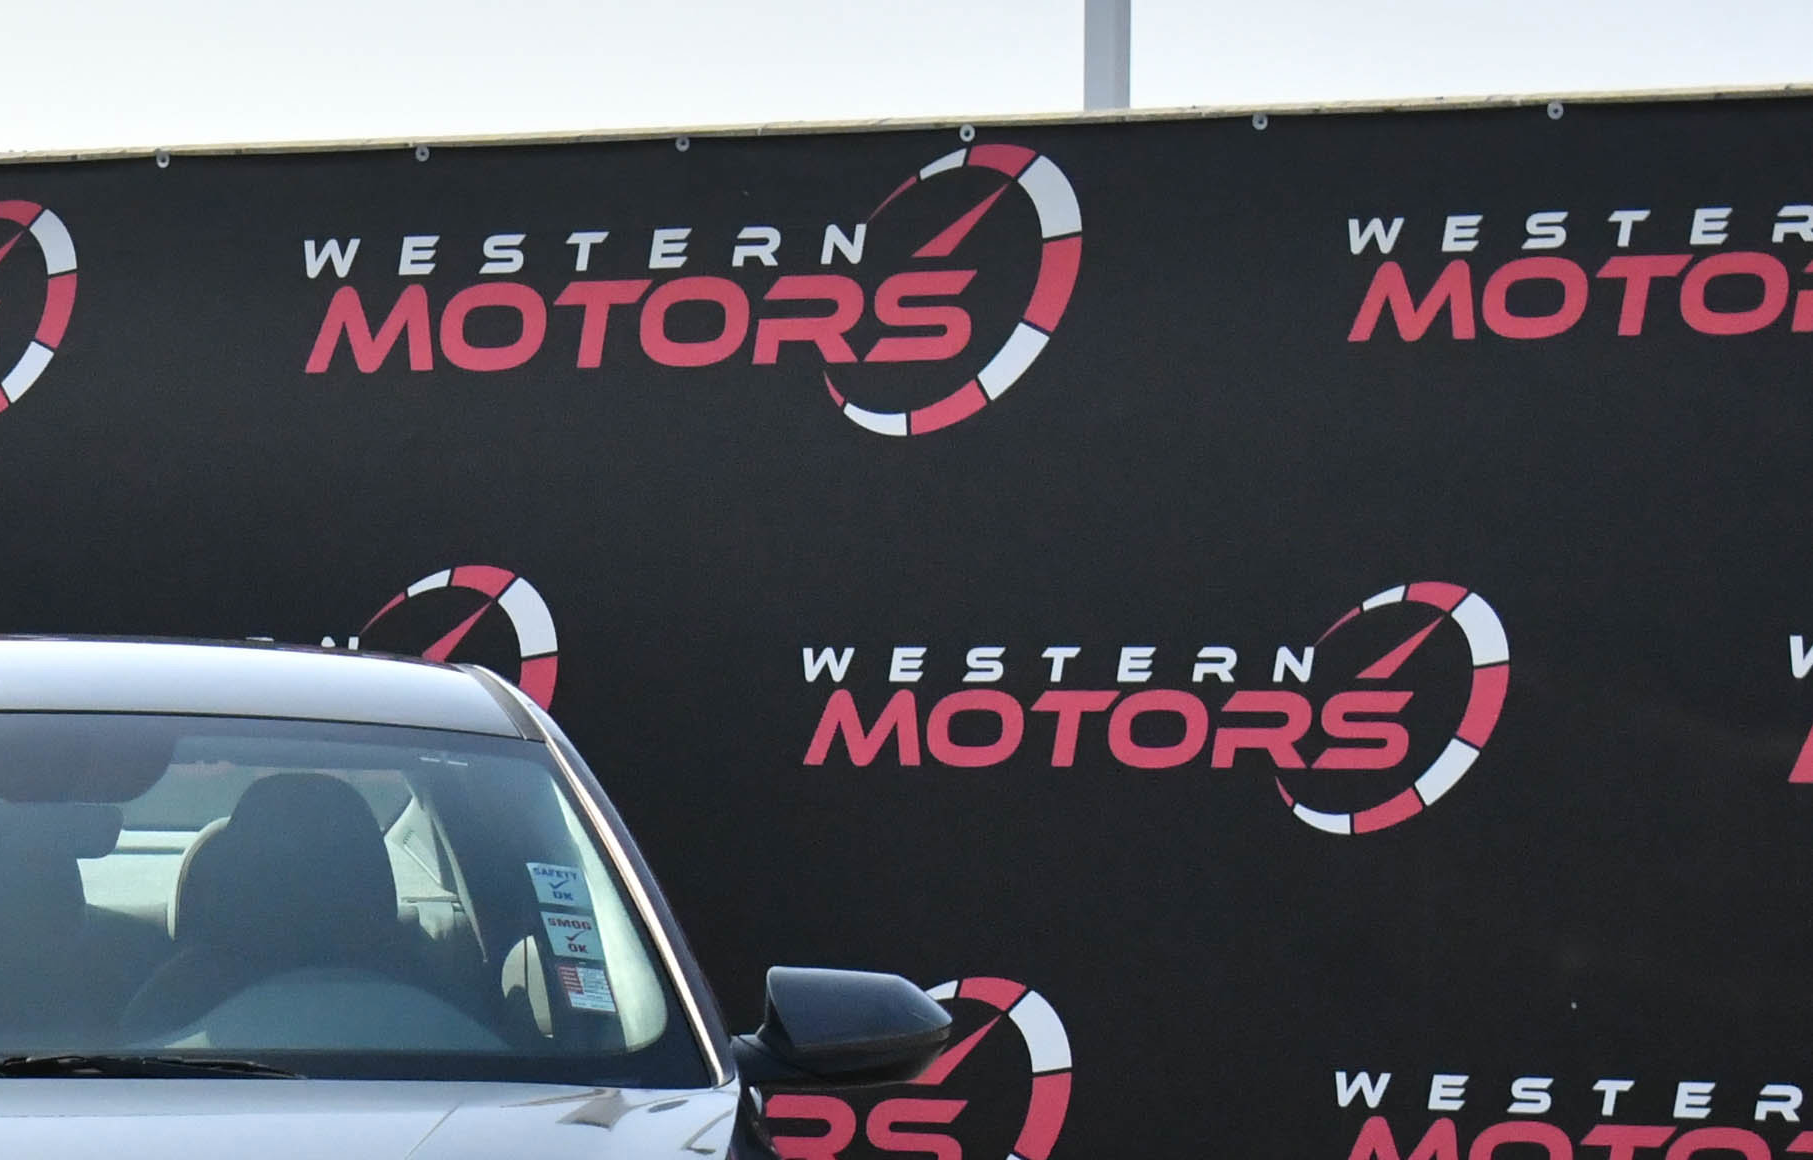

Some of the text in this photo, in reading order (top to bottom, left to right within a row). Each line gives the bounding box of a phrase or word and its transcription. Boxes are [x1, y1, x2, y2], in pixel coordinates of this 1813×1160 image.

[304, 222, 867, 279] WESTERN
[1349, 204, 1813, 254] WESTER
[305, 269, 977, 374] MOTORS
[1347, 251, 1813, 342] MOTO
[803, 646, 1315, 683] WESTERN
[803, 688, 1415, 770] MOTORS
[532, 867, 578, 880] SAFETY
[553, 890, 573, 900] OK
[547, 917, 592, 930] SMOG
[568, 943, 587, 953] OK
[1335, 1071, 1804, 1121] WESTER
